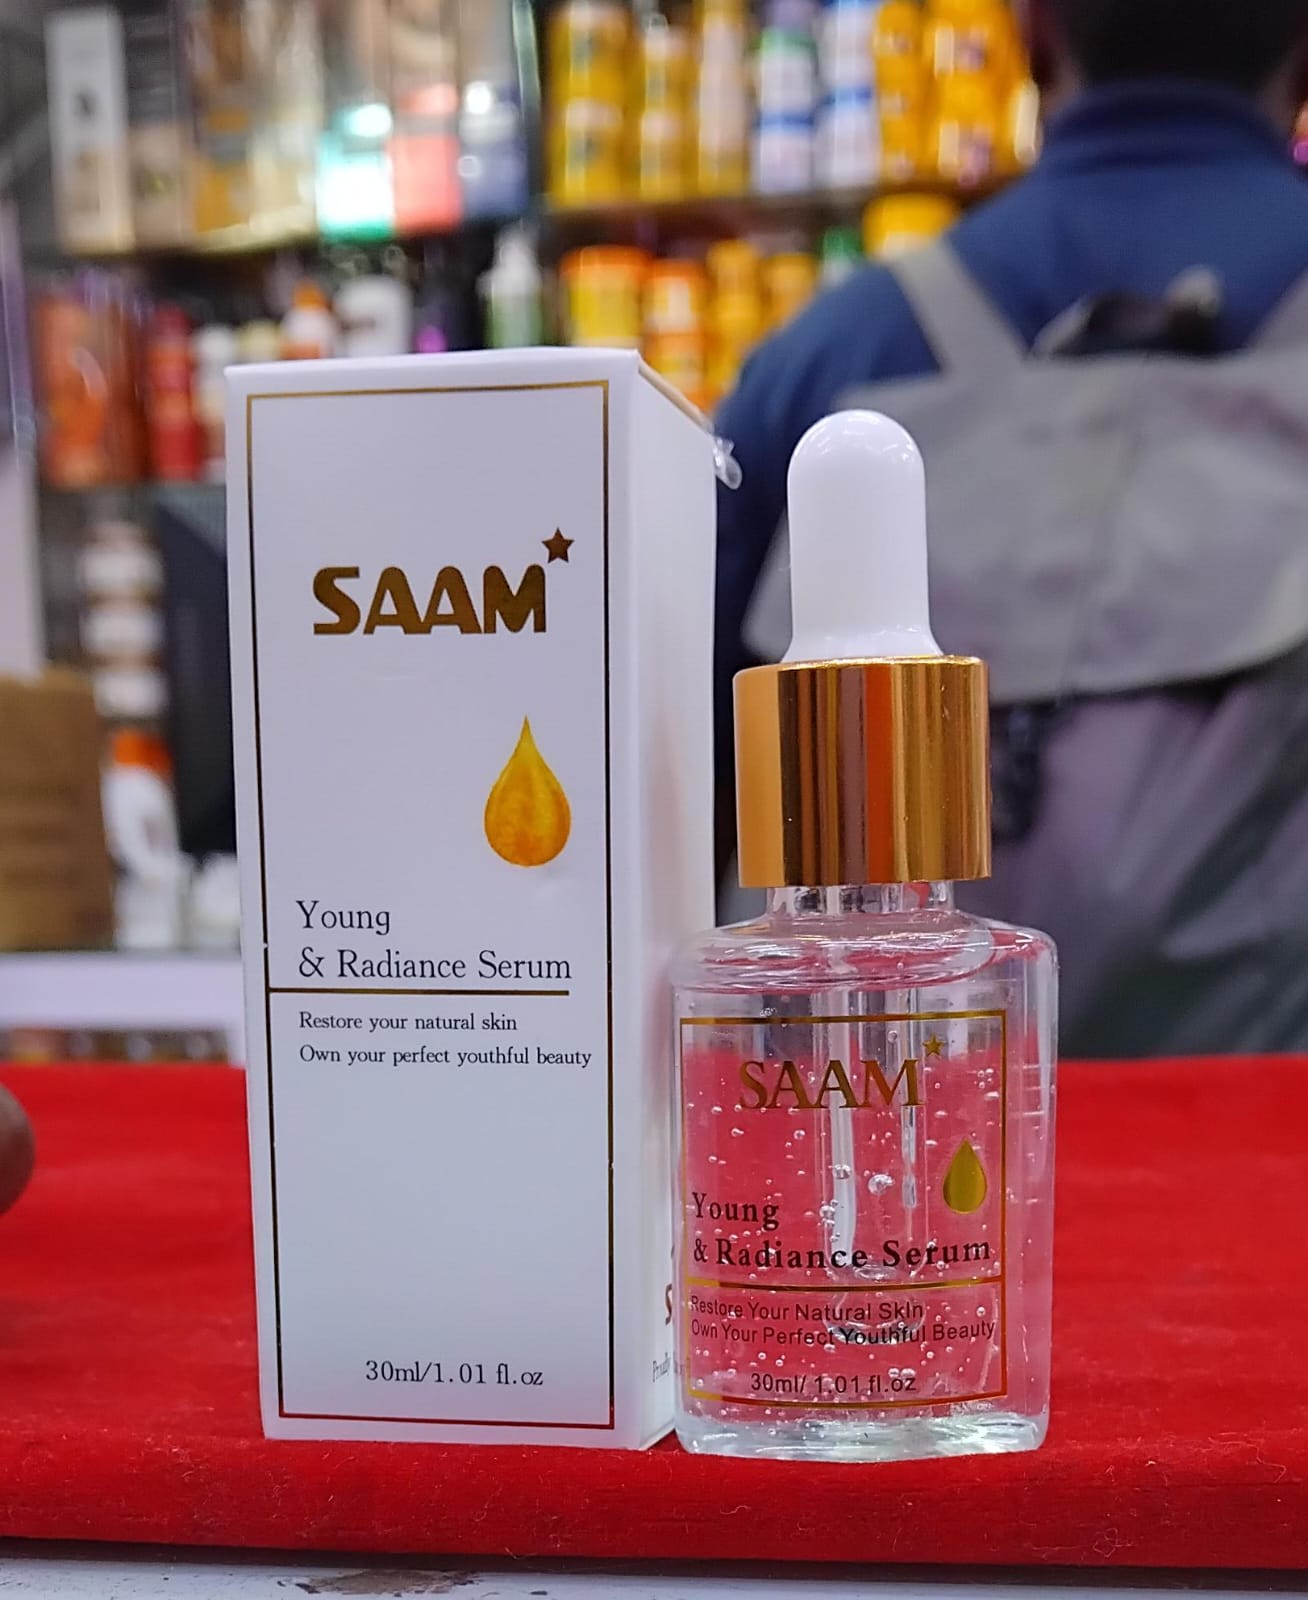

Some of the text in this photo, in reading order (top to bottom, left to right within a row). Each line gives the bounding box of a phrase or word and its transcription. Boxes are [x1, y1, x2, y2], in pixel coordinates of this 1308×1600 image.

[312, 564, 547, 635] SAAM
[296, 900, 391, 936] Young
[299, 946, 572, 980] & Radiance Serum
[299, 1011, 518, 1032] Restore your natural skin
[299, 1044, 592, 1068] Own your perfect youthful beauty
[740, 1059, 925, 1109] SAAM
[692, 1192, 780, 1231] Young
[693, 1237, 991, 1269] & Radiance Serum
[691, 1295, 744, 1318] Restore
[748, 1302, 790, 1320] Your
[795, 1304, 872, 1321] Natural
[691, 1319, 996, 1346] Own Your Perfect Youthful Beauty
[365, 1360, 544, 1386] 30ml/1.01 fl.oz
[751, 1373, 917, 1394] 30ml/ 1.01 fl.oz
